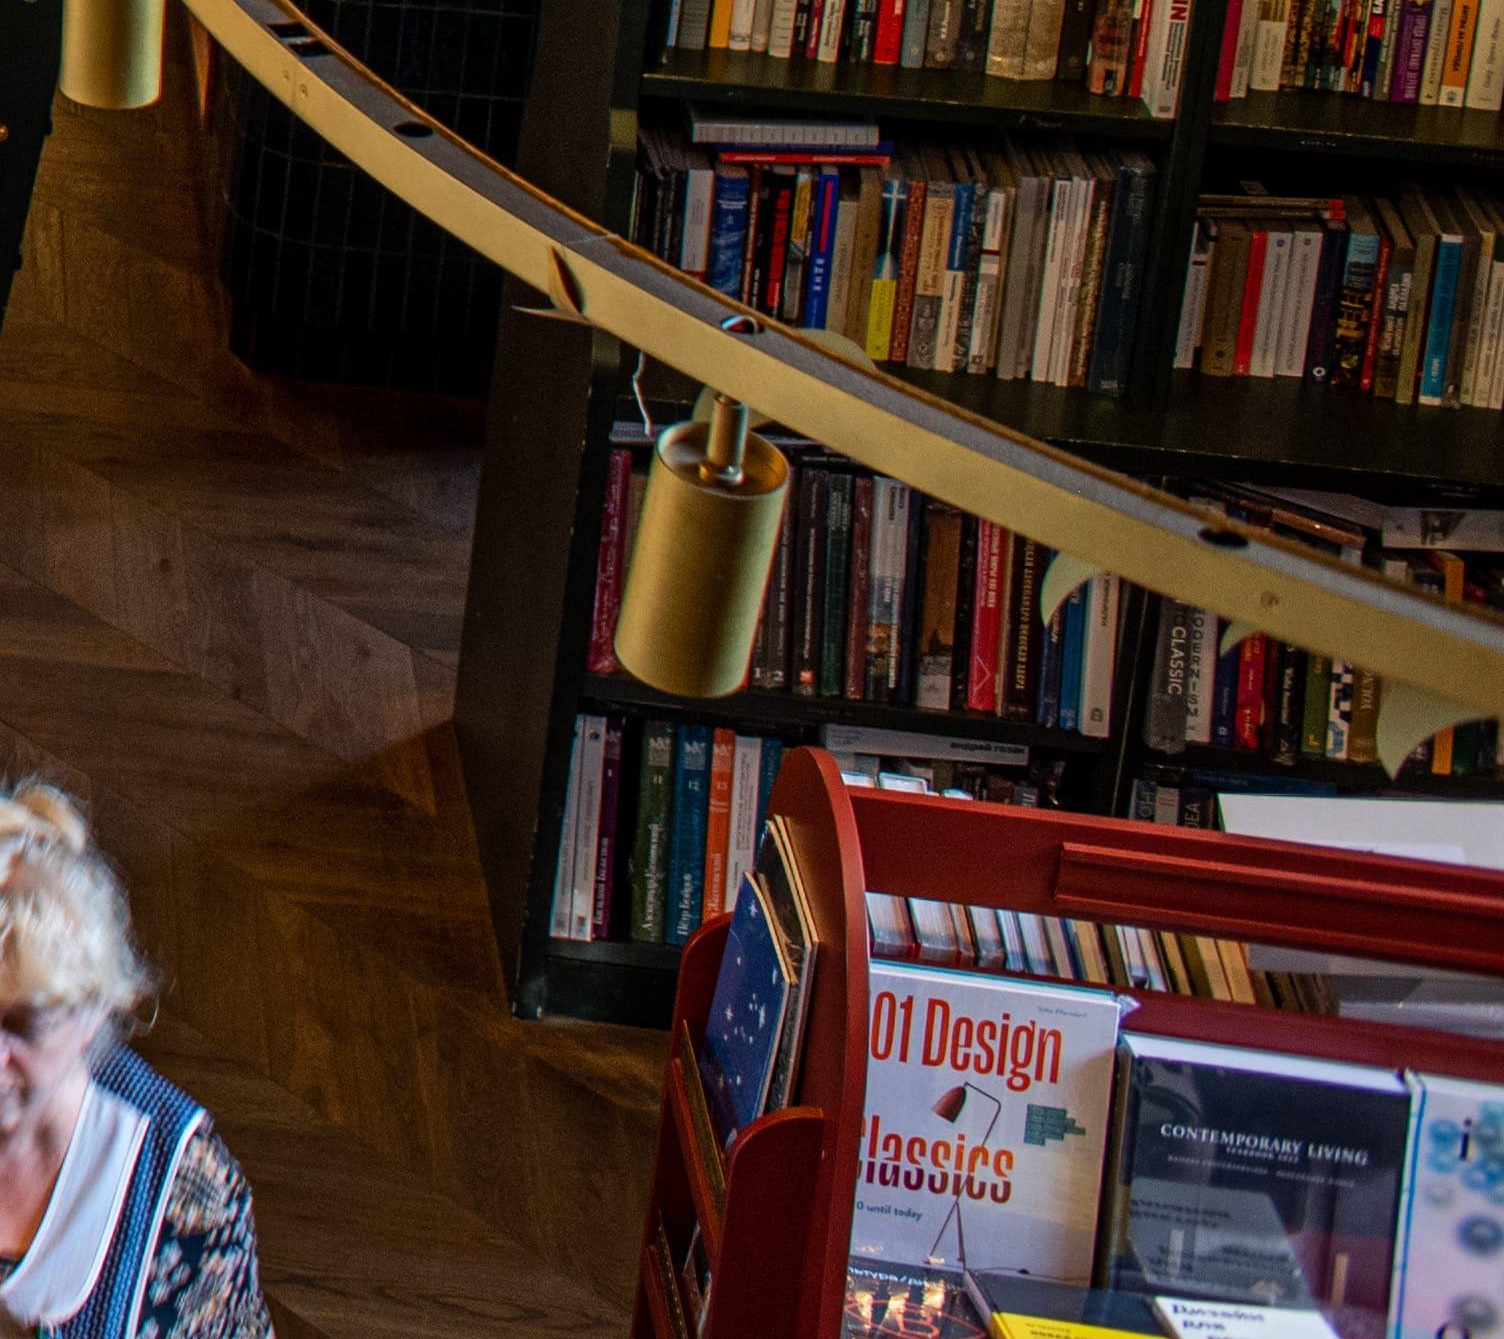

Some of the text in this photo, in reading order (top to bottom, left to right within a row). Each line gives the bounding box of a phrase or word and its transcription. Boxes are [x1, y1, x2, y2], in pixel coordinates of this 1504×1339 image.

[1167, 625, 1188, 697] CLASSIC
[870, 990, 1064, 1092] 01 Design
[1161, 1122, 1370, 1166] CONTEMPORARY LIVING
[868, 1202, 923, 1223] until today
